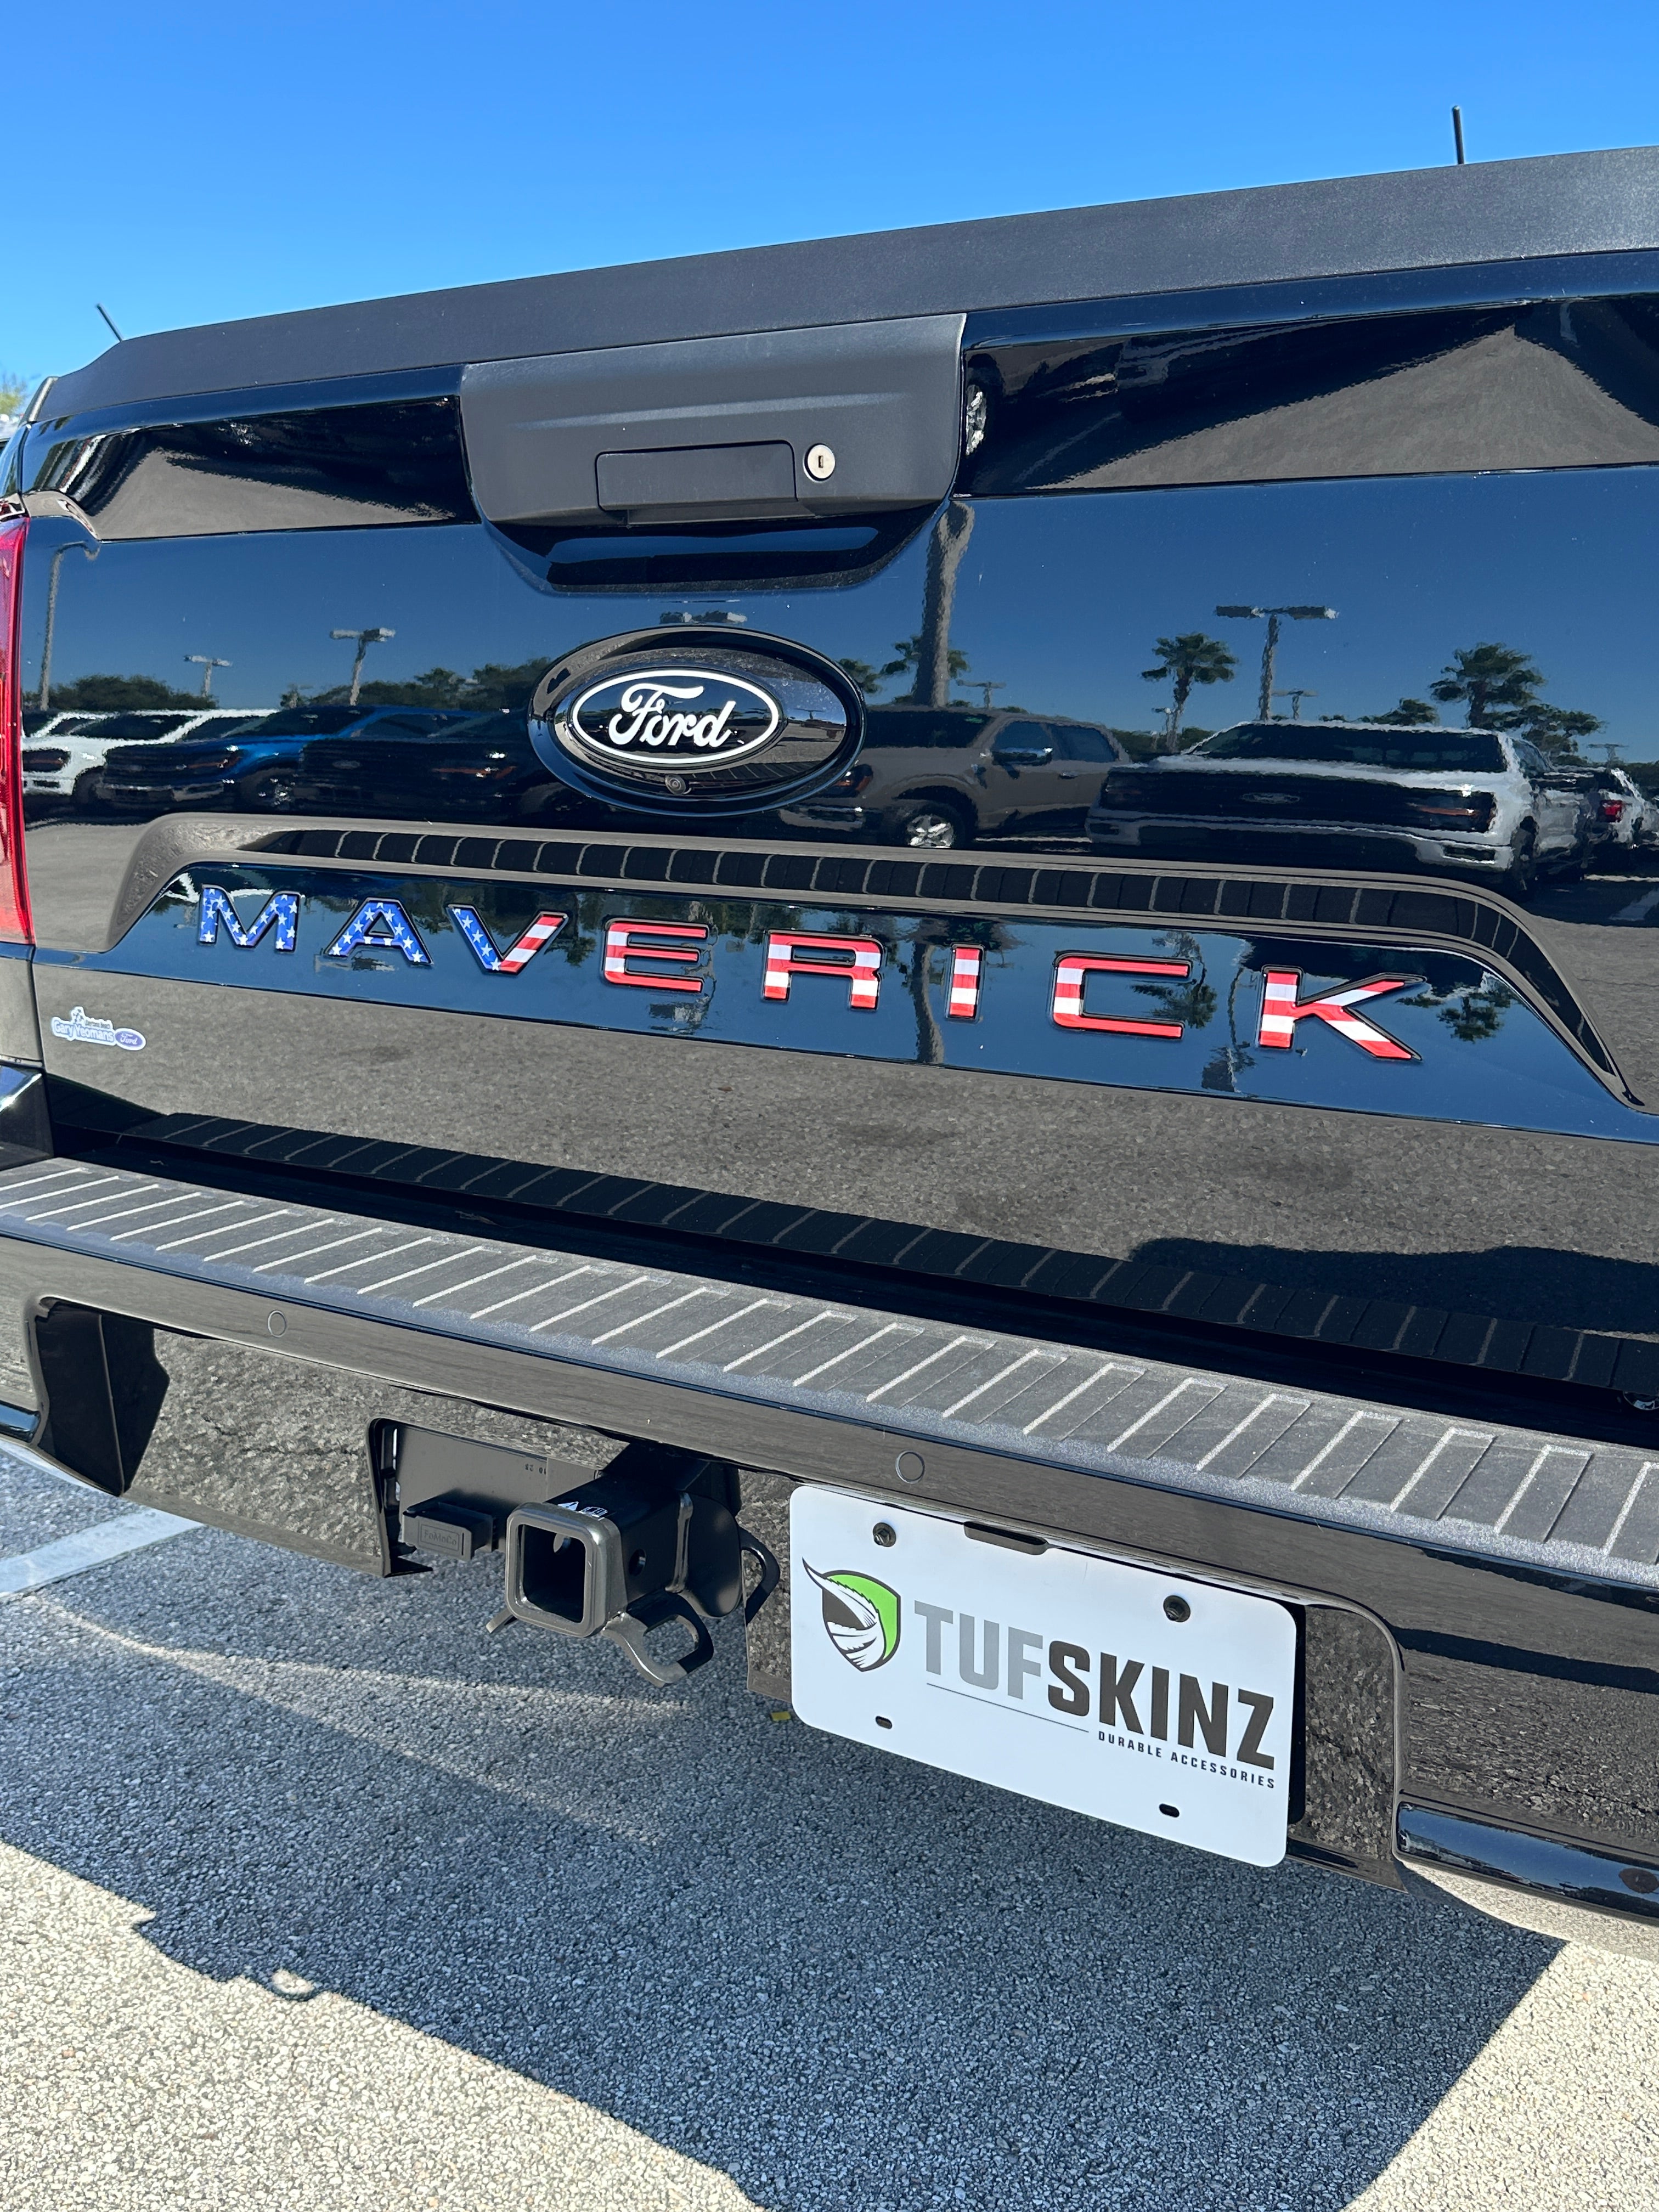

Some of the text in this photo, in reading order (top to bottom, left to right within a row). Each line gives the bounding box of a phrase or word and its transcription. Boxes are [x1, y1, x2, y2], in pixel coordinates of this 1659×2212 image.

[608, 682, 736, 747] Ford
[199, 884, 1426, 1061] MAVERICK
[54, 1020, 74, 1038] Gary
[74, 1023, 115, 1042] Yeomans
[120, 1032, 138, 1045] Ford
[424, 1529, 457, 1545] FoMoCo
[914, 1600, 1275, 1771] TUFSKINZ
[1098, 1730, 1275, 1789] DURABLE ACCESSORIES
